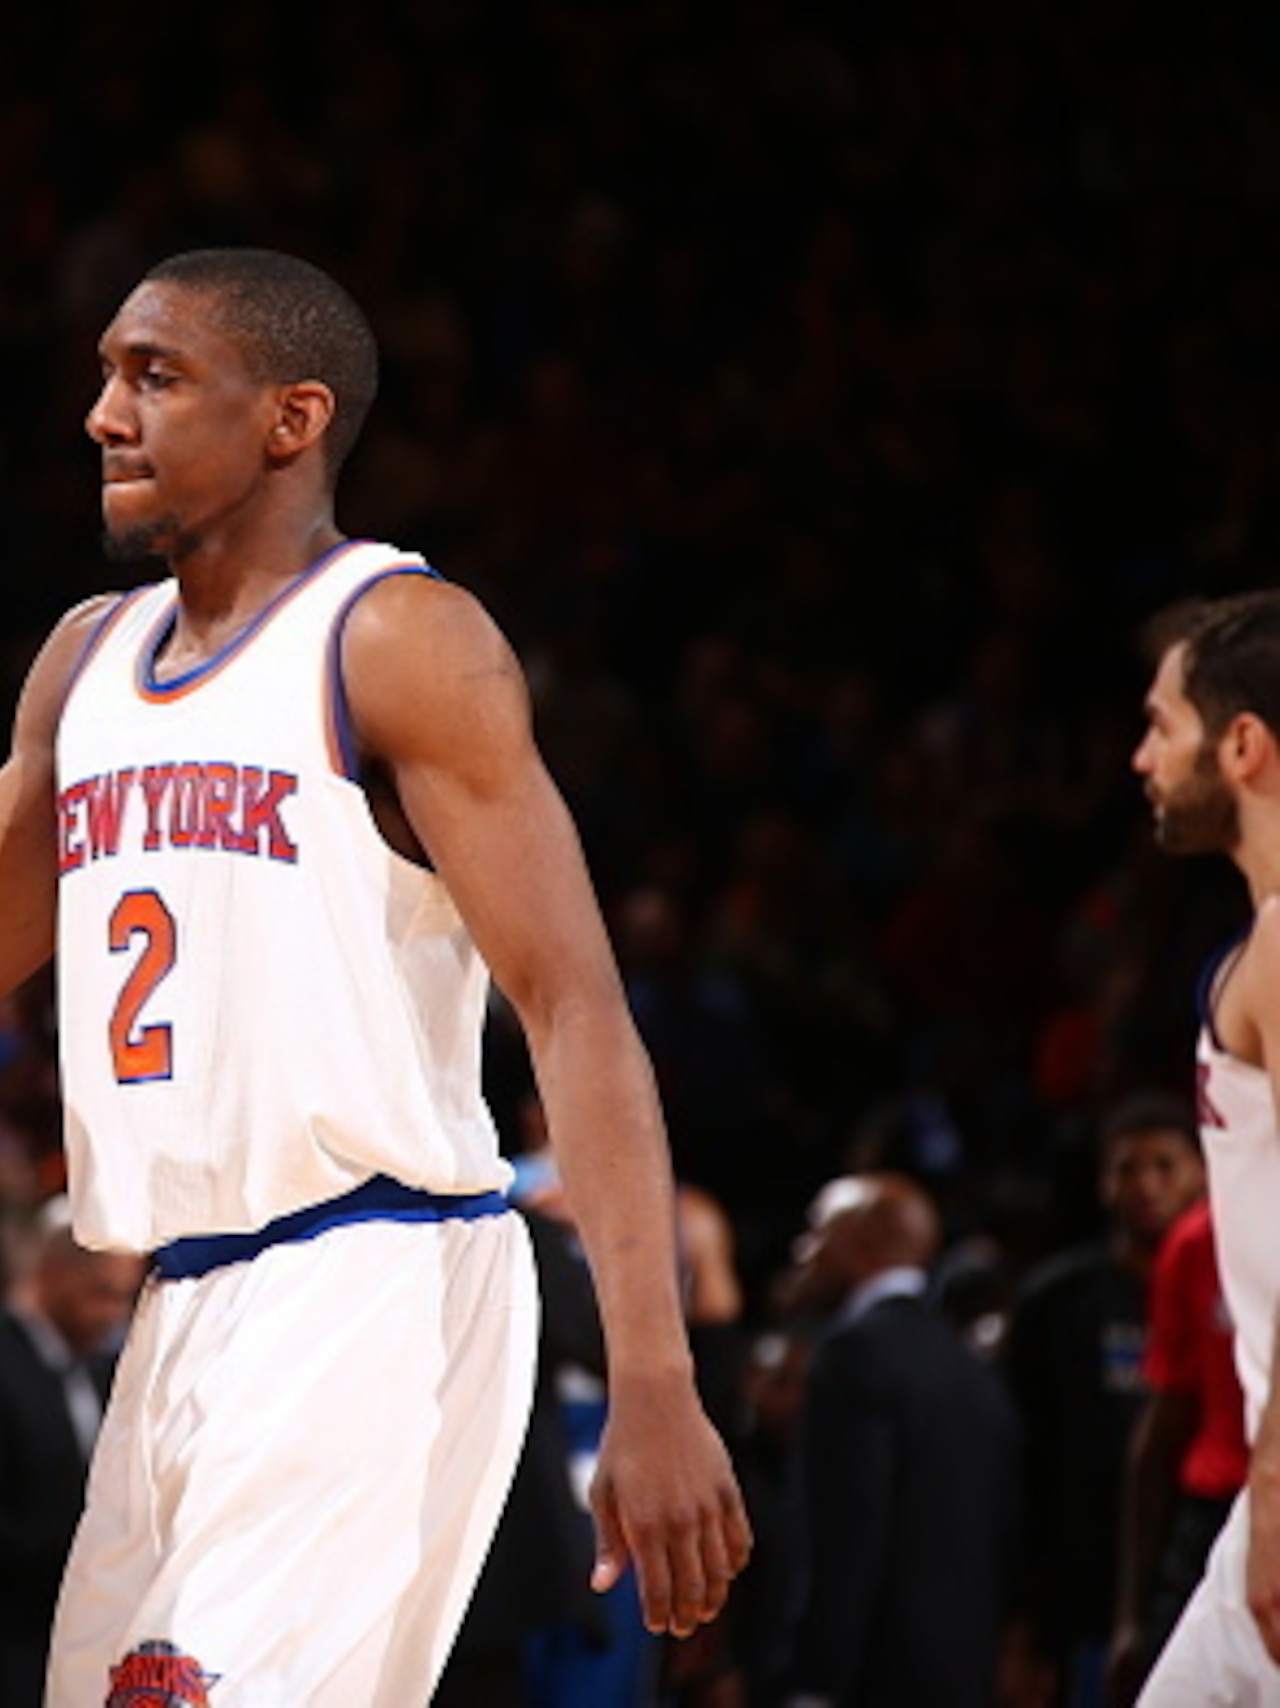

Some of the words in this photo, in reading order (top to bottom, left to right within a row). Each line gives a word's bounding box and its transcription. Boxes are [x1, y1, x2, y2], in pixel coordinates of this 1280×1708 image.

[58, 767, 136, 877] EW
[140, 761, 298, 864] YORK
[108, 887, 176, 1084] 2
